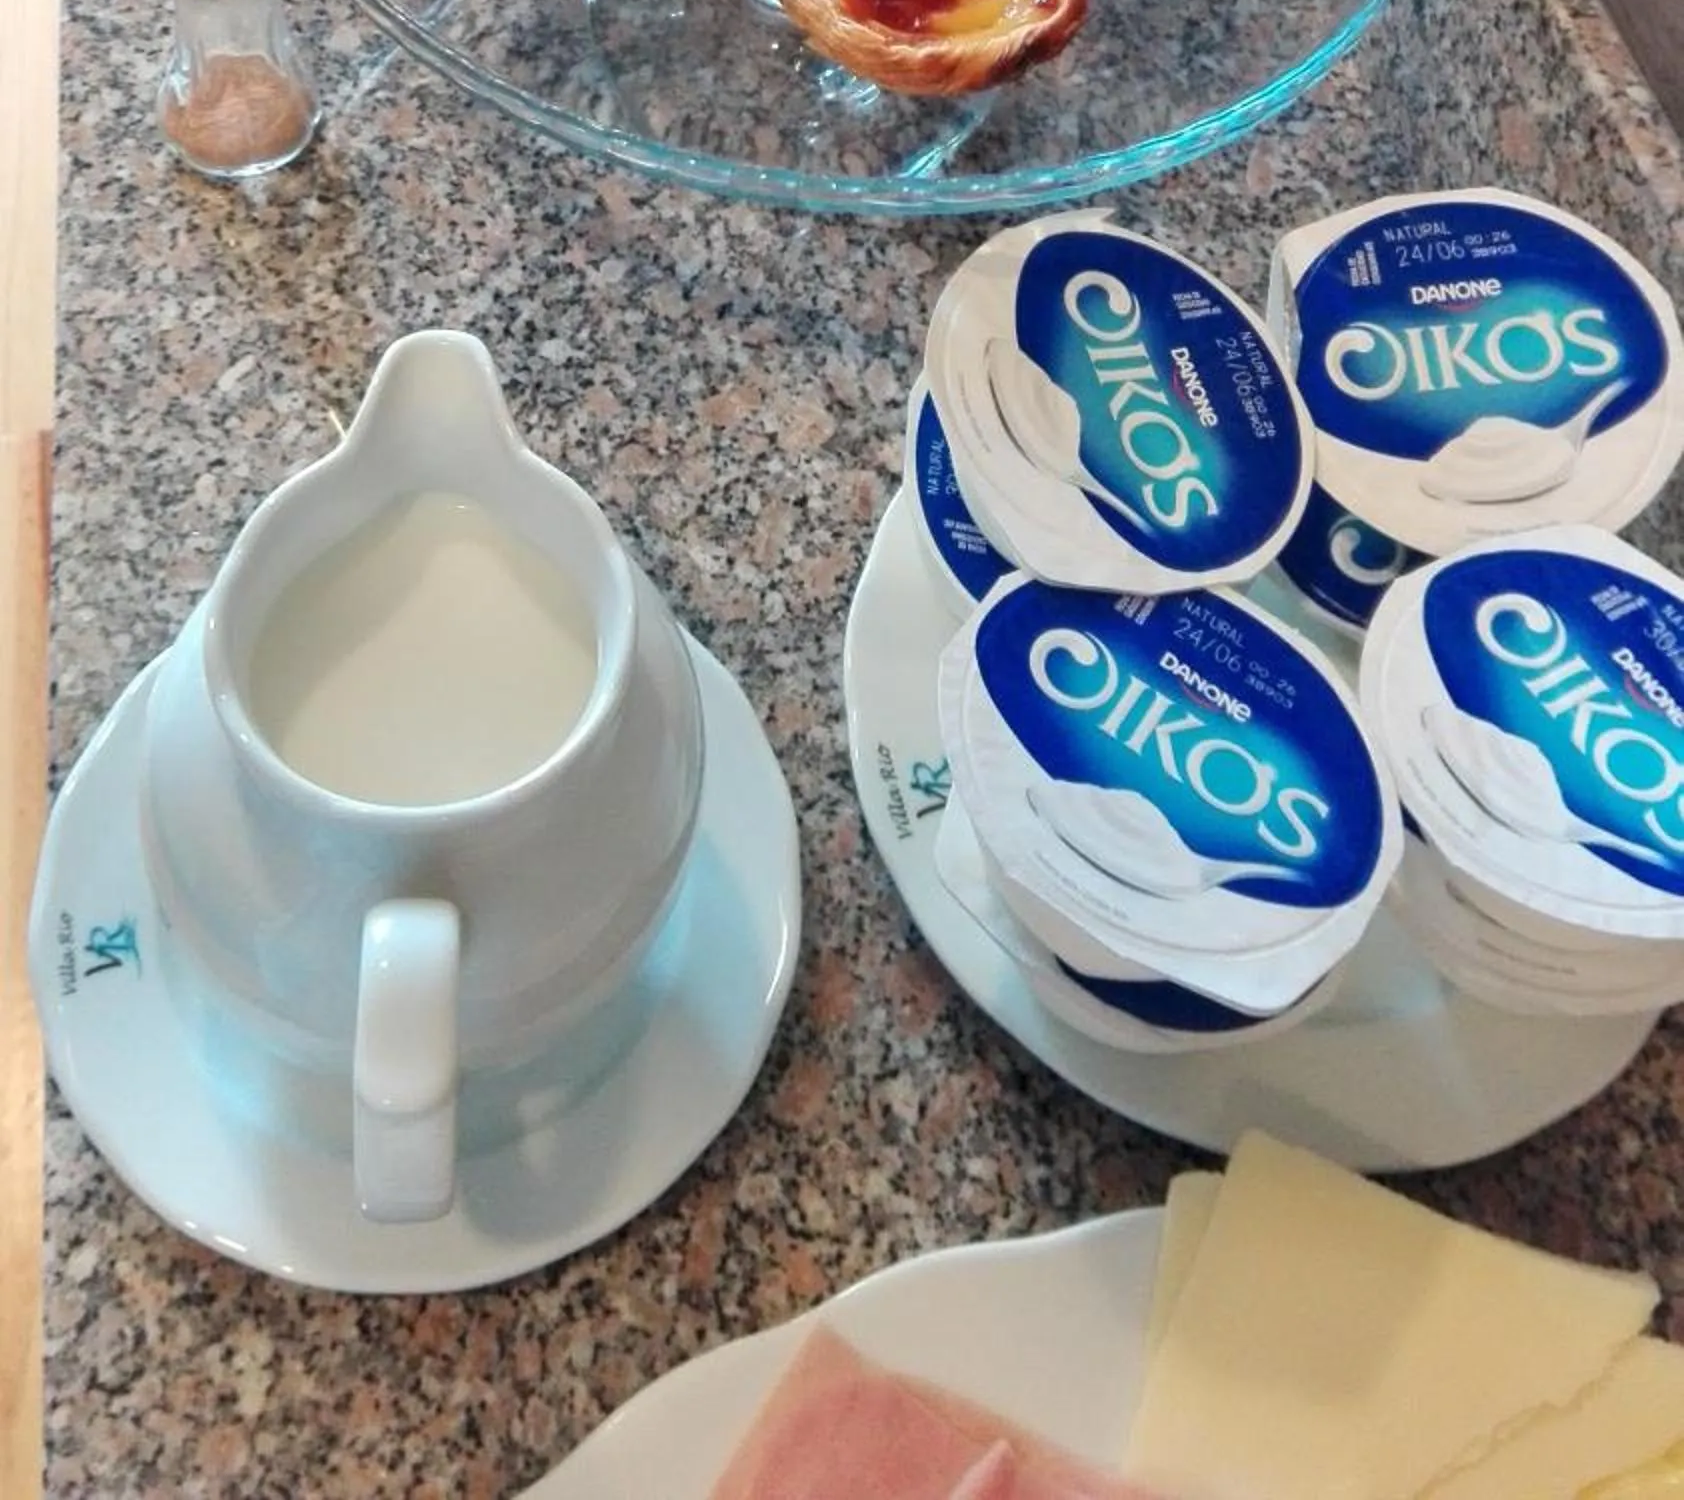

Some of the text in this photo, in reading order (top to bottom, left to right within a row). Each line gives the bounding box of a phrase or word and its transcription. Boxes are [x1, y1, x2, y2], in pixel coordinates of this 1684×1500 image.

[1383, 220, 1452, 243] NATURAL
[1395, 239, 1465, 267] 24/06
[1216, 337, 1257, 397] 24/06
[1325, 309, 1620, 401] OIKOS
[1063, 270, 1219, 528] OIKOS
[1173, 617, 1242, 673] 24/06
[1181, 596, 1247, 648] NATURAL
[1029, 628, 1329, 859] OIKOS
[878, 744, 912, 839] Villa Rio
[58, 946, 78, 996] Villa
